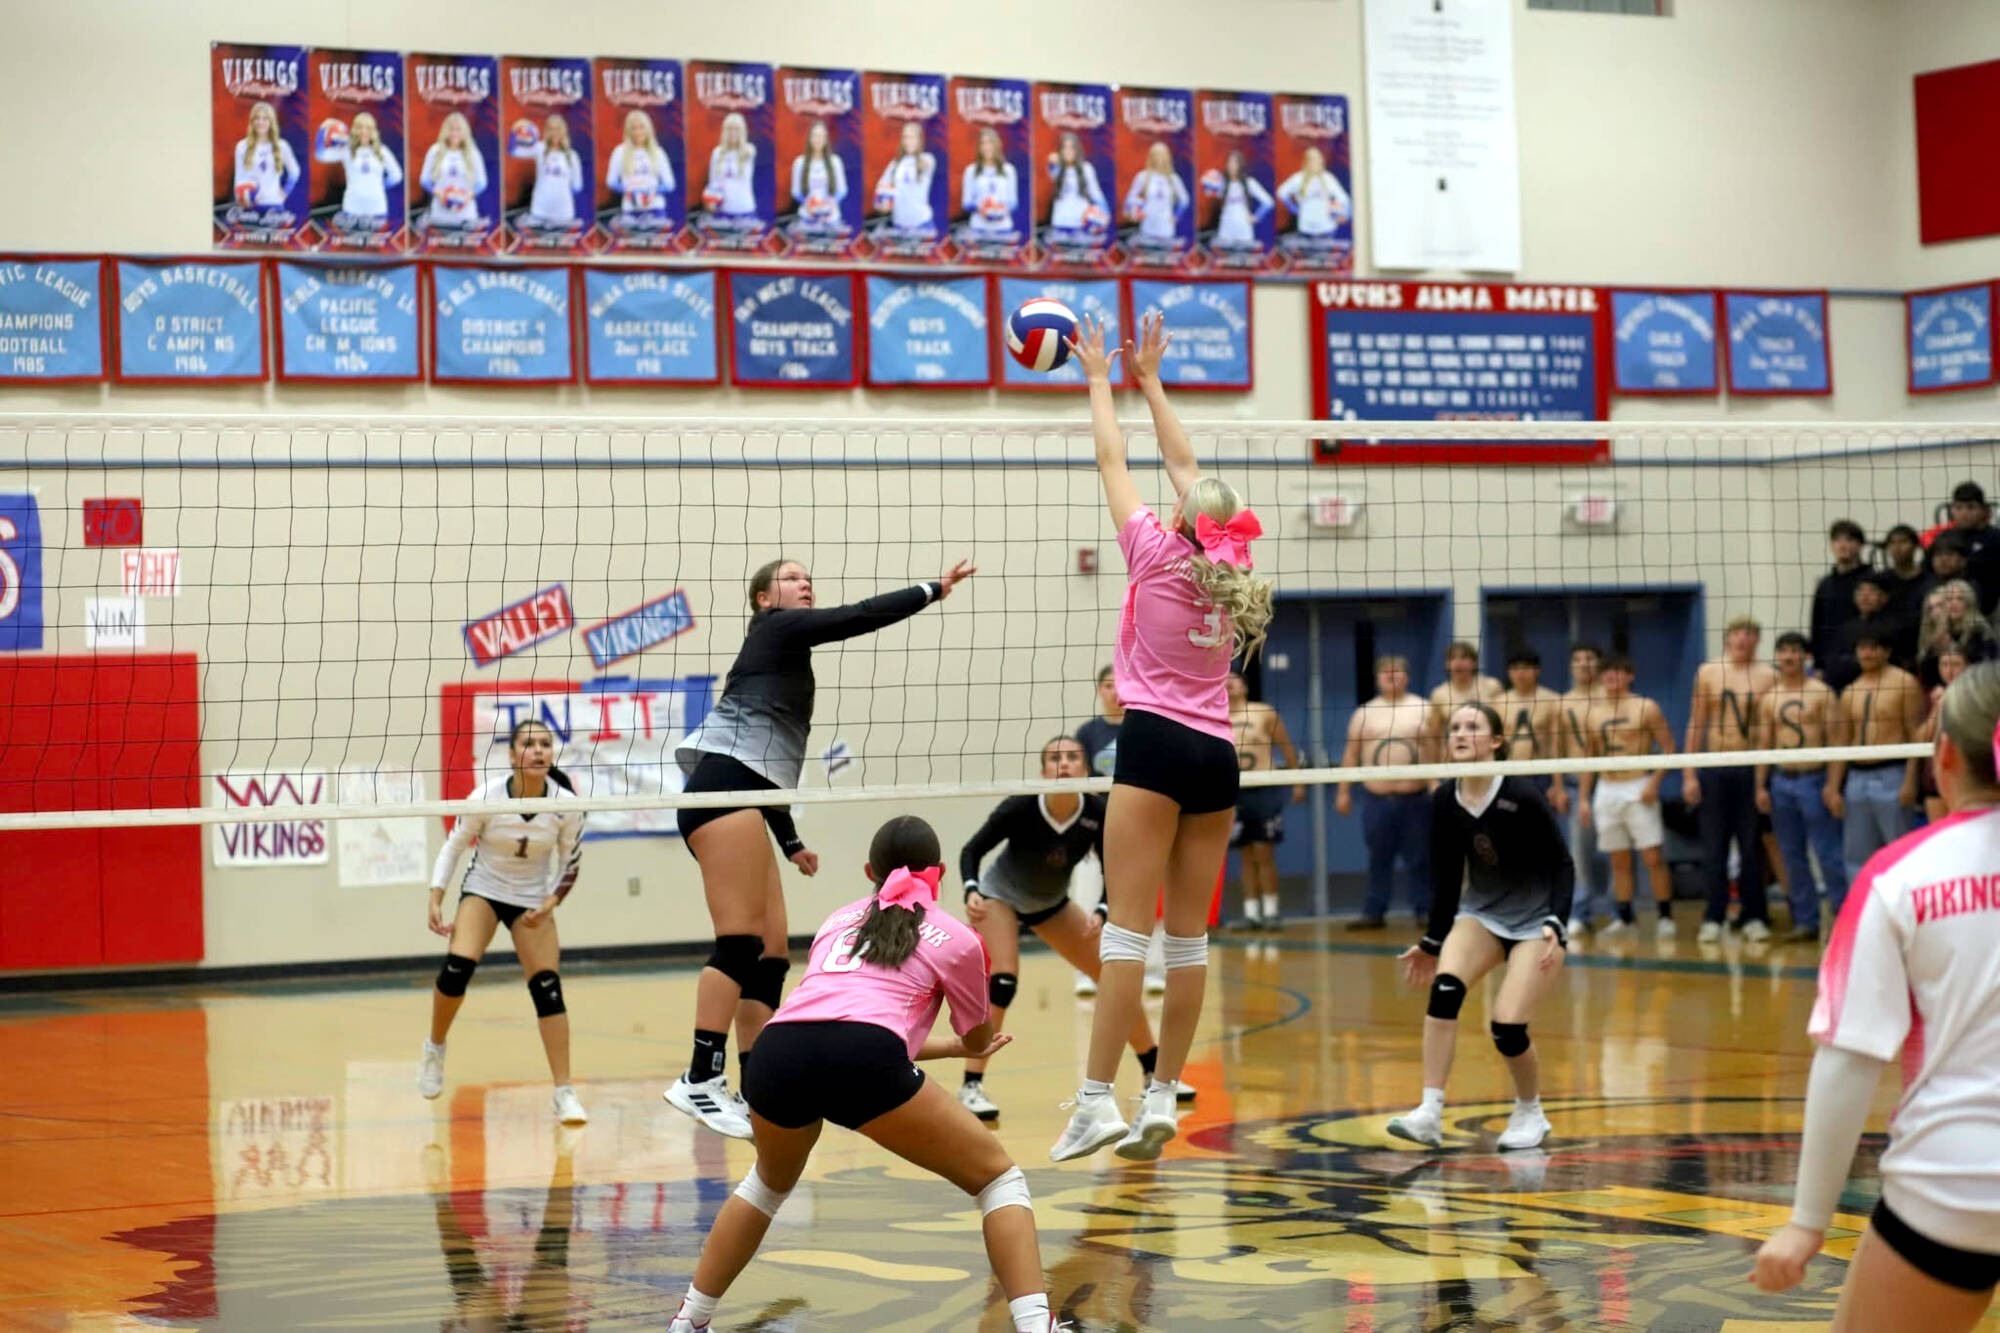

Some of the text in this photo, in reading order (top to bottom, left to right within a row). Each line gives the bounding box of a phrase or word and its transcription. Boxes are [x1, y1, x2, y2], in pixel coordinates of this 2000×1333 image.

[222, 58, 298, 91] VIKINGS
[319, 63, 395, 96] VIKINGS
[416, 65, 490, 98] VIKINGS
[510, 67, 583, 99] VIKINGS
[603, 69, 675, 101] VIKINGS
[695, 72, 766, 105] VIKINGS
[783, 77, 853, 109] VIKINGS
[871, 82, 940, 113] VIKINGS
[956, 87, 1023, 118] VIKINGS
[1040, 92, 1106, 123] VIKINGS
[1121, 97, 1187, 128] VIKINGS
[35, 266, 91, 309] LEAGUE
[160, 266, 258, 314] BASKETBALL
[325, 270, 416, 315] BASKETBLL
[438, 271, 567, 318] GRLS BASKETBALL
[1415, 284, 1492, 310] ALMA
[1504, 286, 1598, 312] MATER
[319, 298, 379, 315] PACIFIC
[155, 315, 223, 333] DSTRICT
[320, 317, 379, 334] LEAGUE
[462, 318, 528, 337] DISTRICT
[604, 321, 698, 338] BASKETBALL
[147, 336, 235, 352] CAMPINS
[305, 334, 398, 352] CHMIONS
[462, 337, 546, 355] CHAMPIONS
[643, 340, 690, 356] PLACE
[87, 500, 140, 543] GO
[124, 551, 179, 595] FIGHT
[90, 608, 135, 637] WIN
[473, 588, 569, 657] VALLEY
[588, 599, 687, 664] VIKINGS
[1187, 599, 1224, 649] 3
[493, 693, 658, 744] IN IT
[220, 819, 326, 859] VIKINGS
[514, 836, 529, 859] 1
